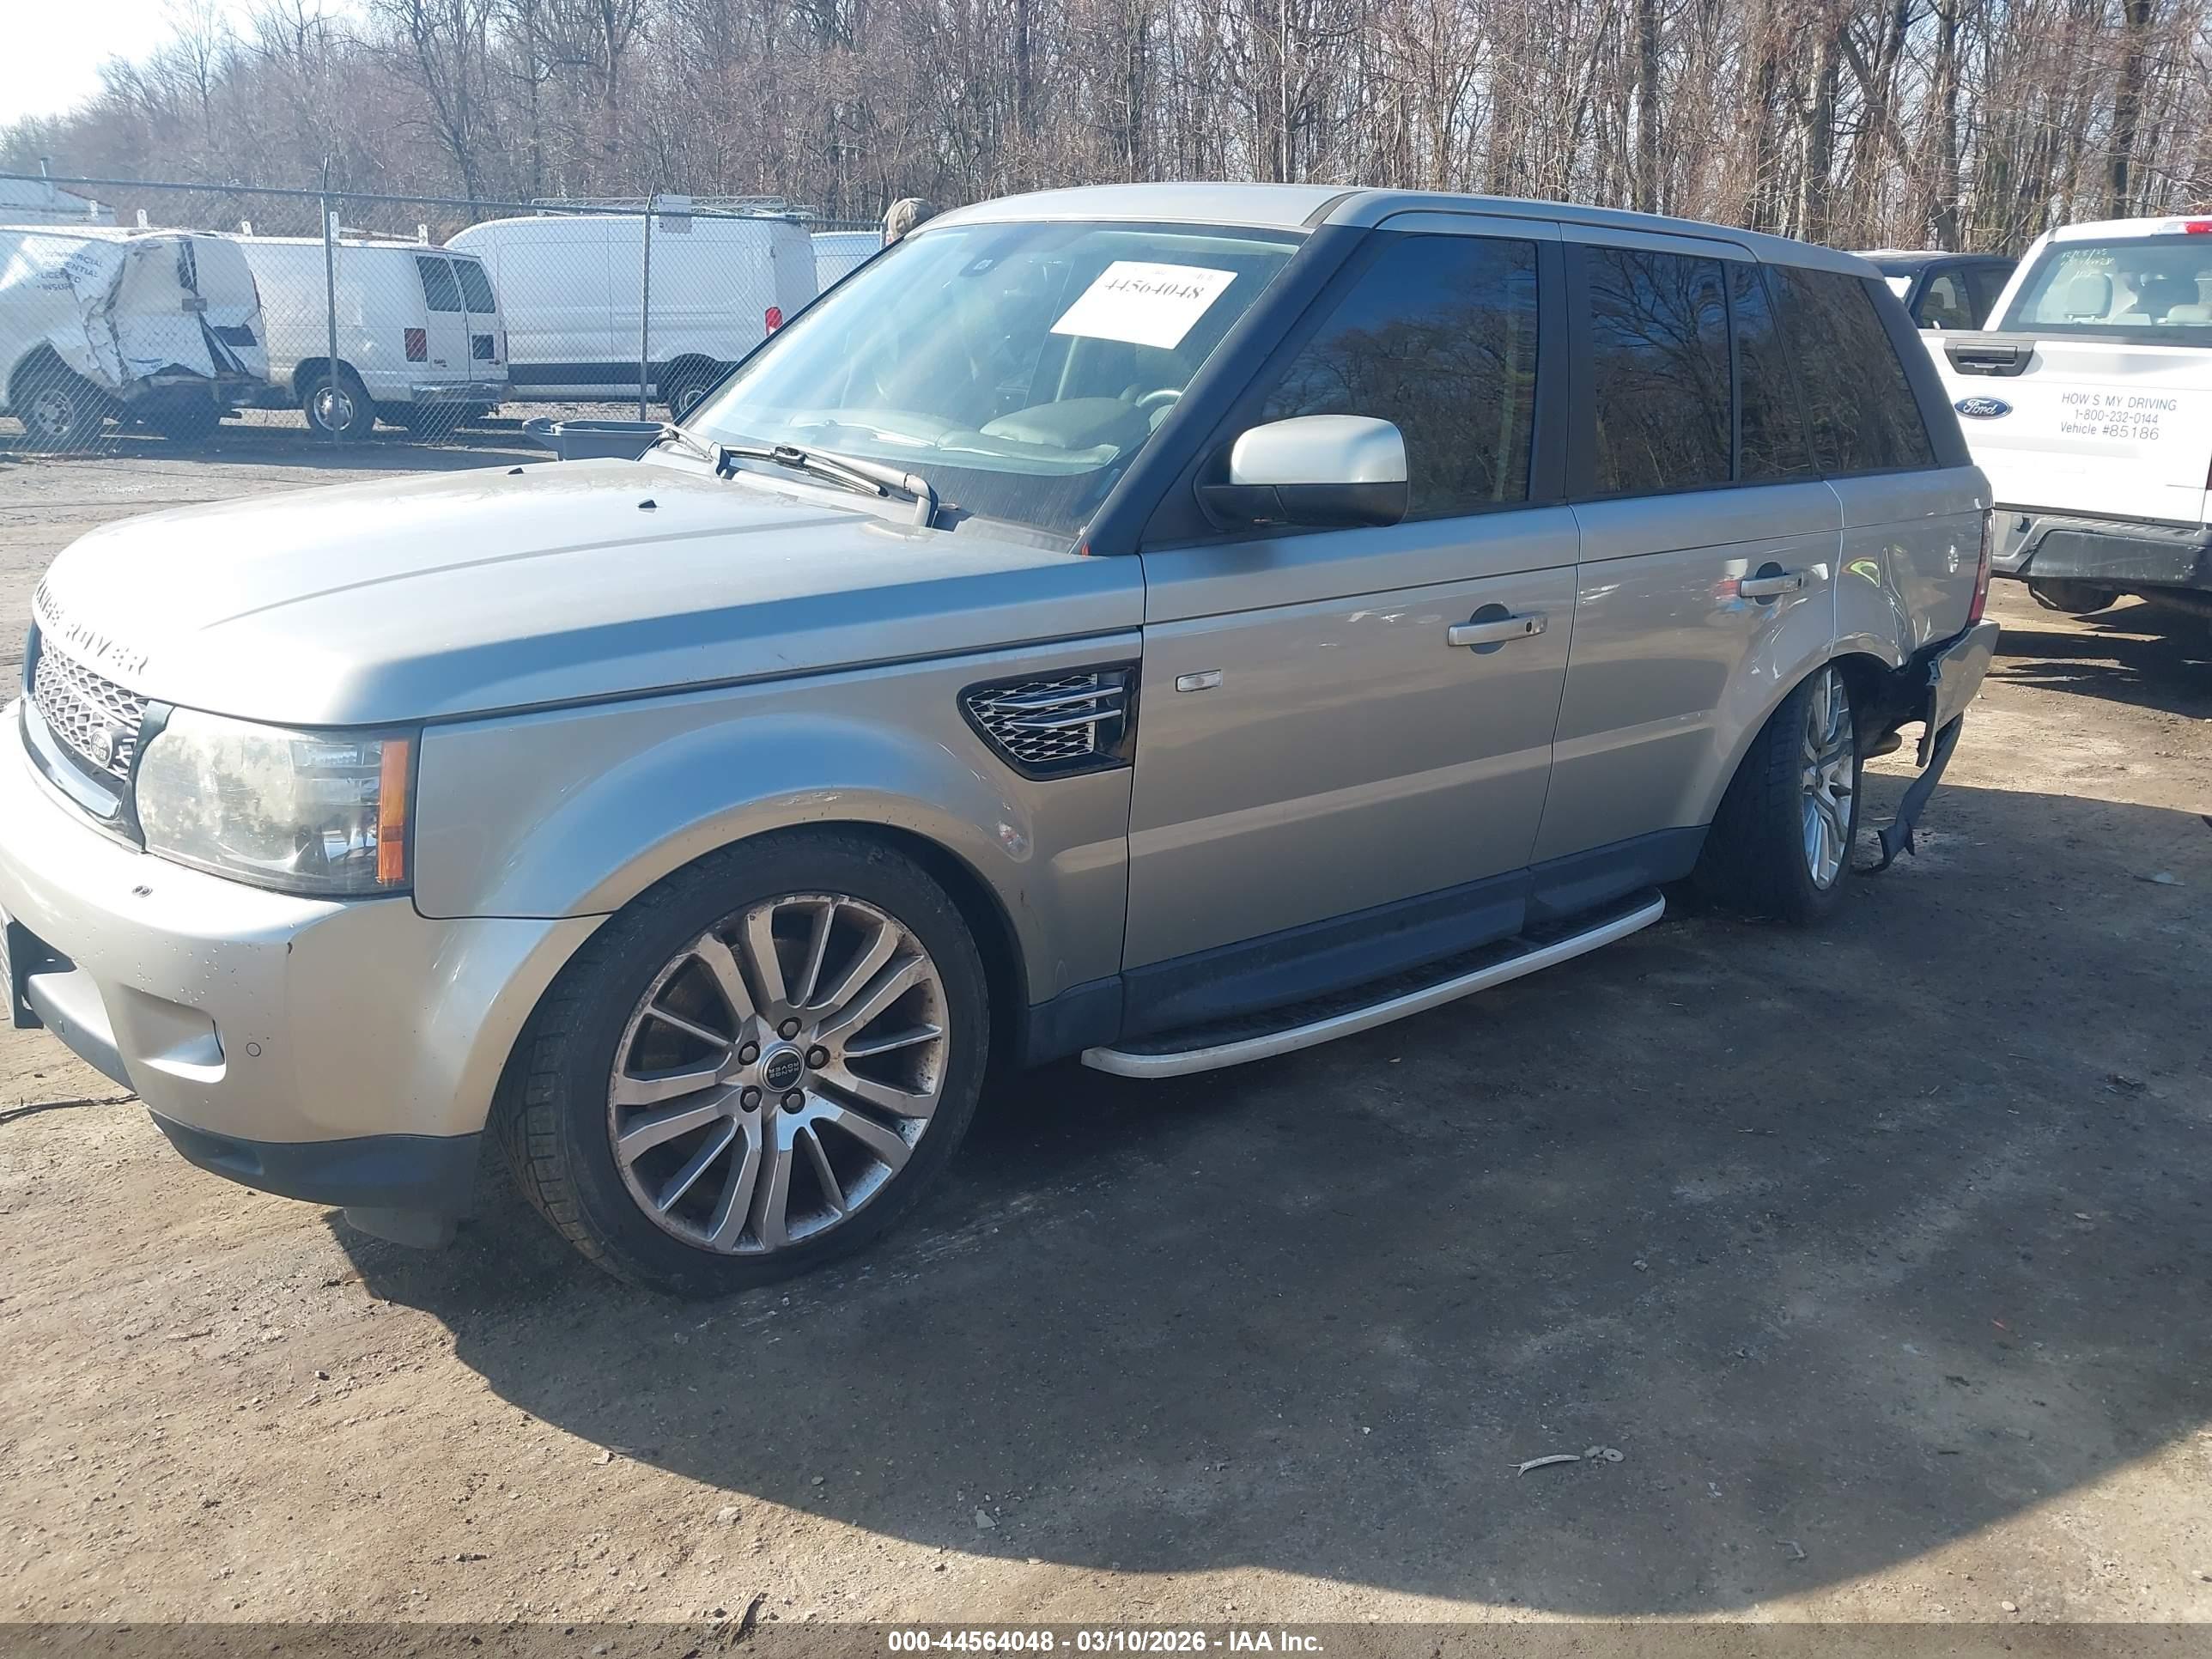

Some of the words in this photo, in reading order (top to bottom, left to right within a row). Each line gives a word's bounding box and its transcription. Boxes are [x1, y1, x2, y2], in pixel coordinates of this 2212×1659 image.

[1963, 398, 1999, 415] Ford
[2105, 395, 2124, 407] MY
[2128, 396, 2178, 411] DRIVING
[2075, 409, 2159, 424] 1-800-232-0144
[2061, 420, 2098, 434] Vehicle
[2102, 424, 2160, 440] #85186
[769, 1061, 799, 1073] ROVER
